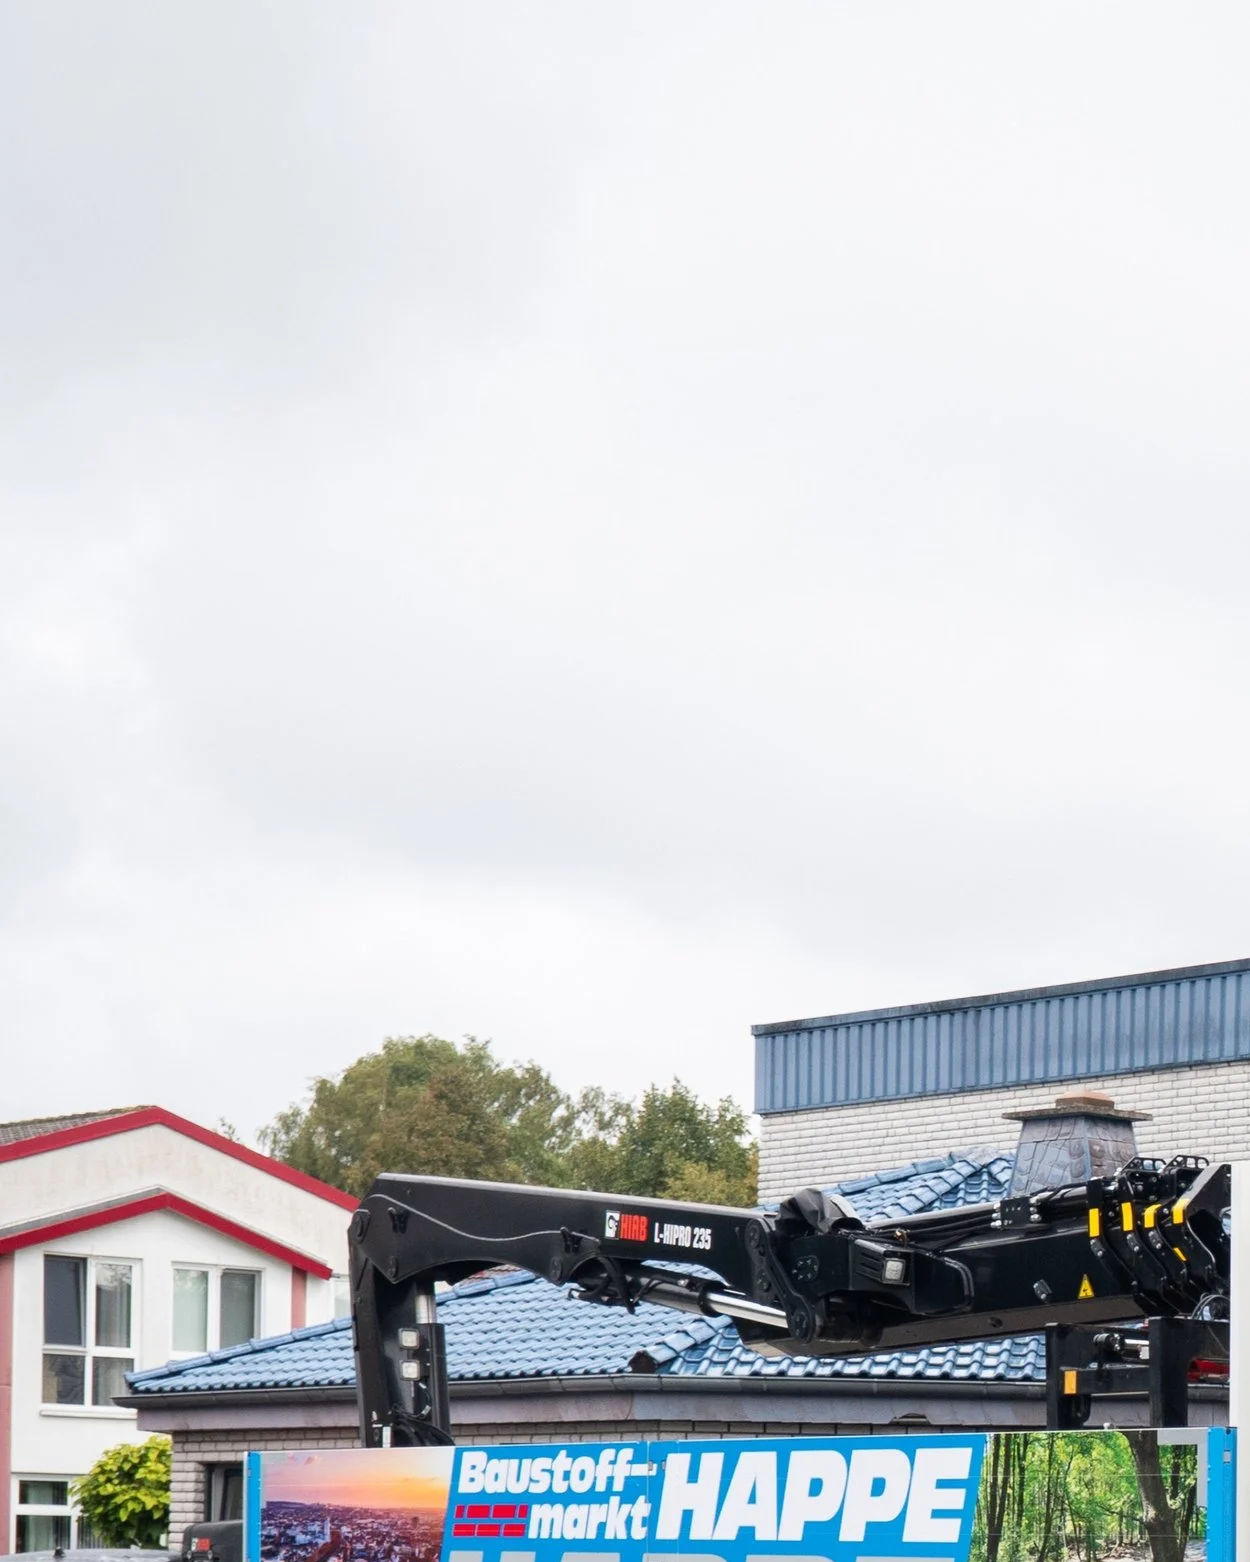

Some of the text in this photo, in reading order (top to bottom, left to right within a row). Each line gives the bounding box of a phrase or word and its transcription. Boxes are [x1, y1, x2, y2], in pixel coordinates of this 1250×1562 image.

[620, 1213, 648, 1242] HIAB
[654, 1222, 712, 1250] L-HIPRO 235
[457, 1448, 657, 1494] Baustoff-
[527, 1495, 651, 1540] markt
[656, 1447, 973, 1543] HAPPE
